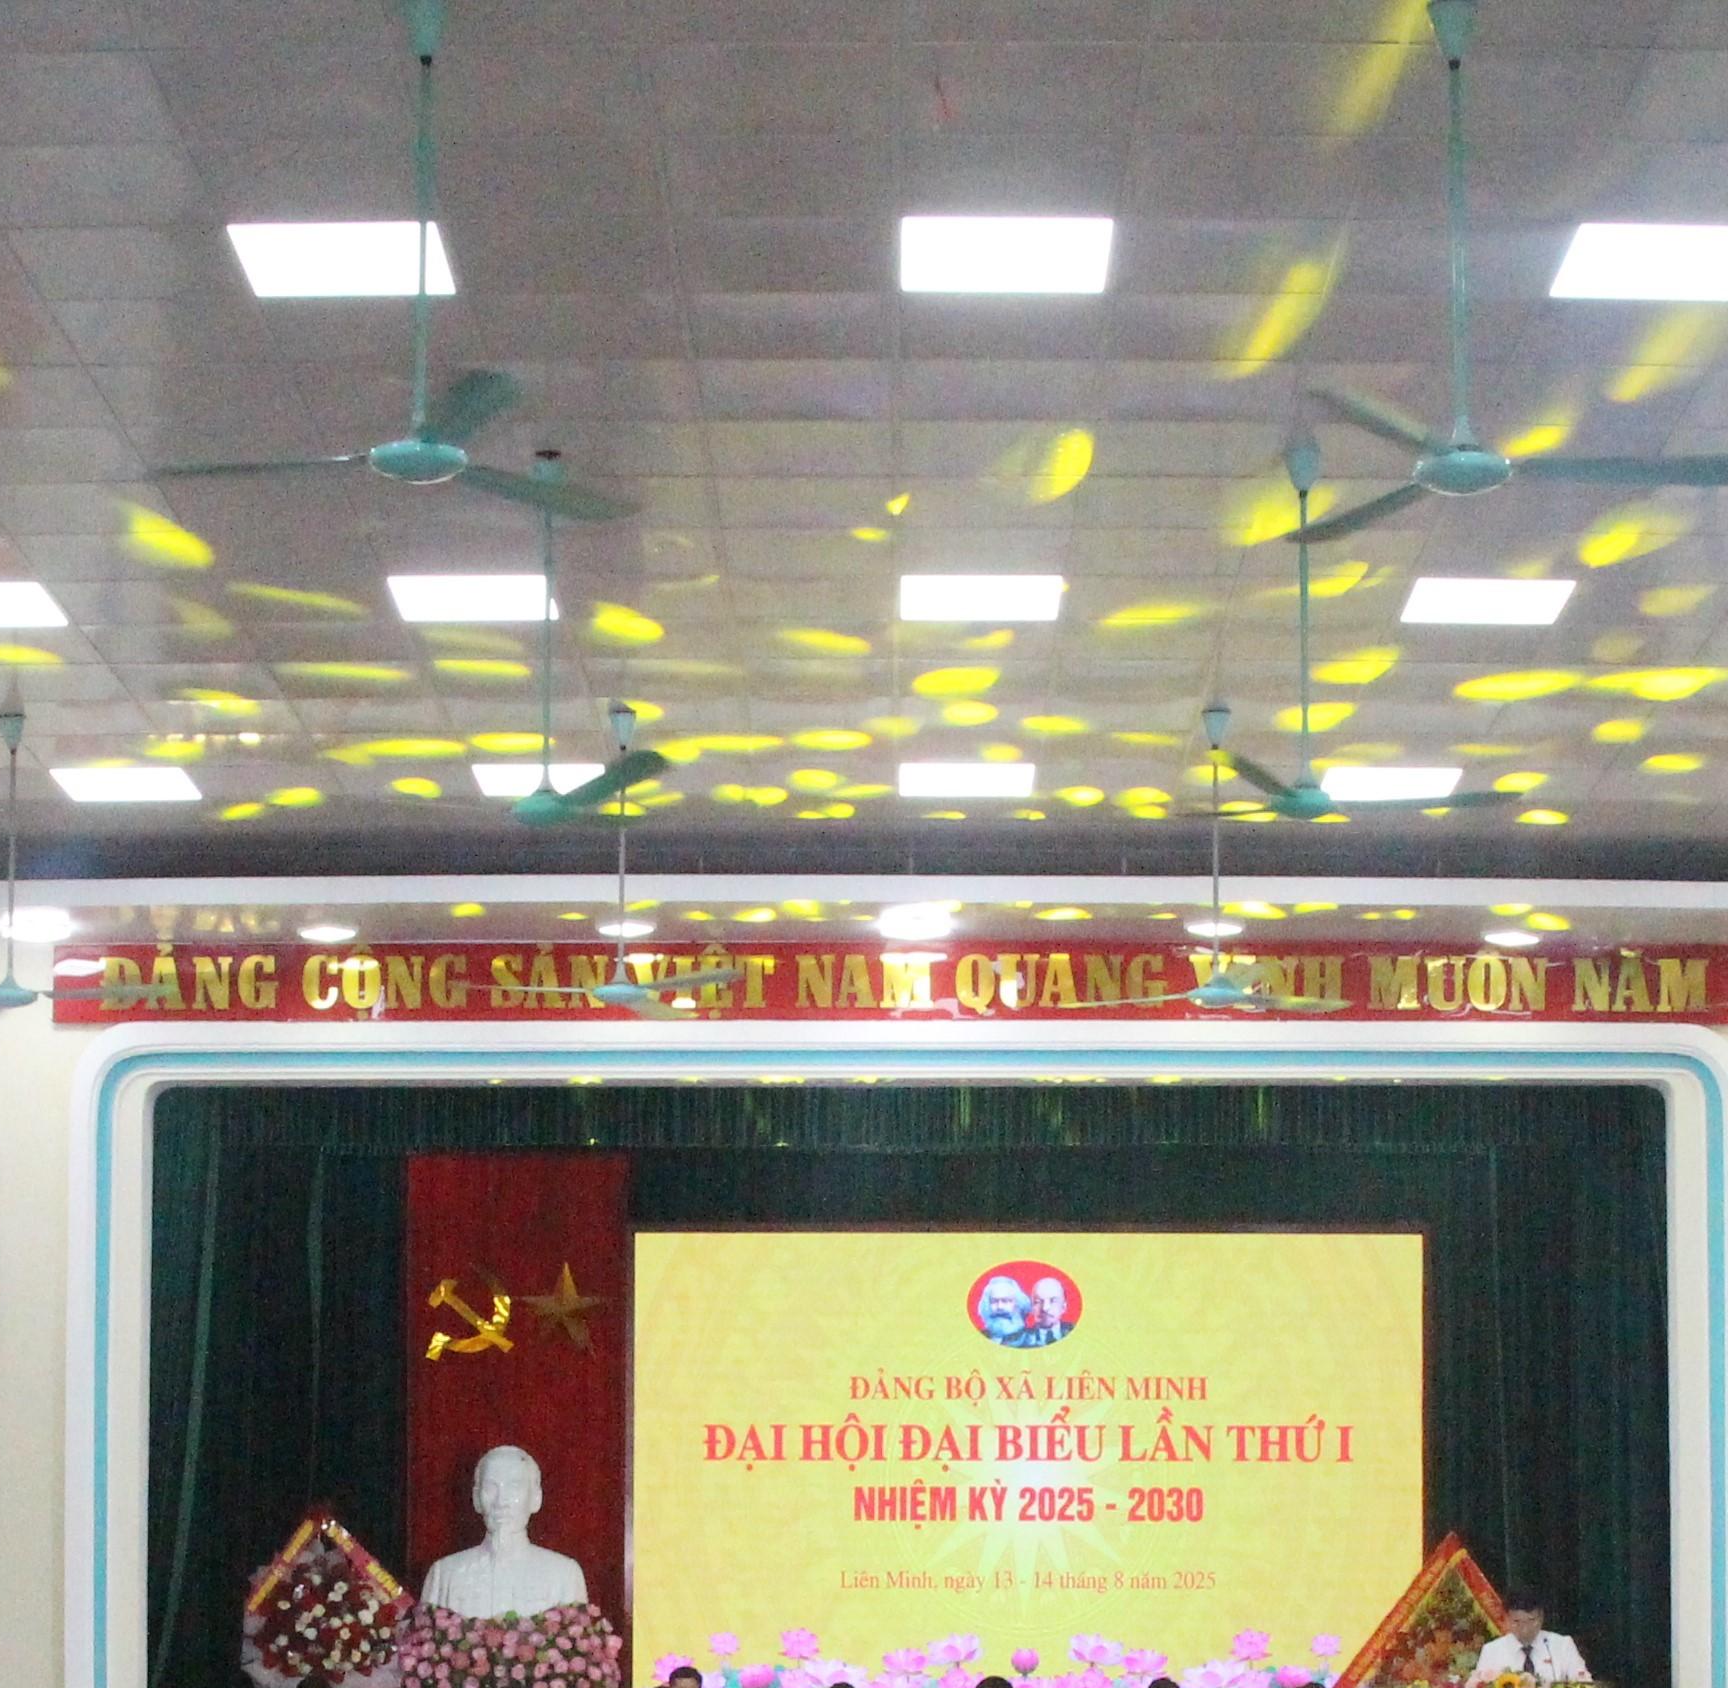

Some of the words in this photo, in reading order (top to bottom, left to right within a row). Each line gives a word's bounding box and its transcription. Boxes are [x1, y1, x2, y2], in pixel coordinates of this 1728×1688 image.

[99, 941, 276, 1010] ĐẢNG
[302, 943, 468, 1019] CỘNG
[795, 952, 940, 1010] NAM
[955, 952, 1168, 1015] QUANG
[850, 1367, 933, 1400] ĐẢNG
[946, 1371, 986, 1407] BỘ
[997, 1369, 1034, 1400] XÃ
[1047, 1370, 1115, 1400] LIÊN
[1127, 1376, 1208, 1400] MINH
[703, 1424, 785, 1471] ĐẠI
[801, 1412, 886, 1472] HỘI
[900, 1424, 981, 1472] ĐẠI
[997, 1405, 1104, 1462] BIỂU
[1120, 1406, 1212, 1462] LẦN
[1227, 1413, 1326, 1462] THỨ
[1337, 1424, 1352, 1462] I
[854, 1480, 957, 1529] NHIỆM
[969, 1478, 1007, 1521] KỲ
[1018, 1487, 1095, 1522] 2025
[1127, 1487, 1204, 1522] 2030
[840, 1571, 879, 1590] Liên
[888, 1571, 937, 1593] Minh,
[944, 1574, 989, 1597] ngày
[994, 1573, 1013, 1590] 13
[1035, 1573, 1053, 1590] 14
[1058, 1570, 1108, 1597] tháng
[1114, 1573, 1124, 1590] 8
[1129, 1574, 1169, 1590] năm
[1173, 1573, 1216, 1590] 2025
